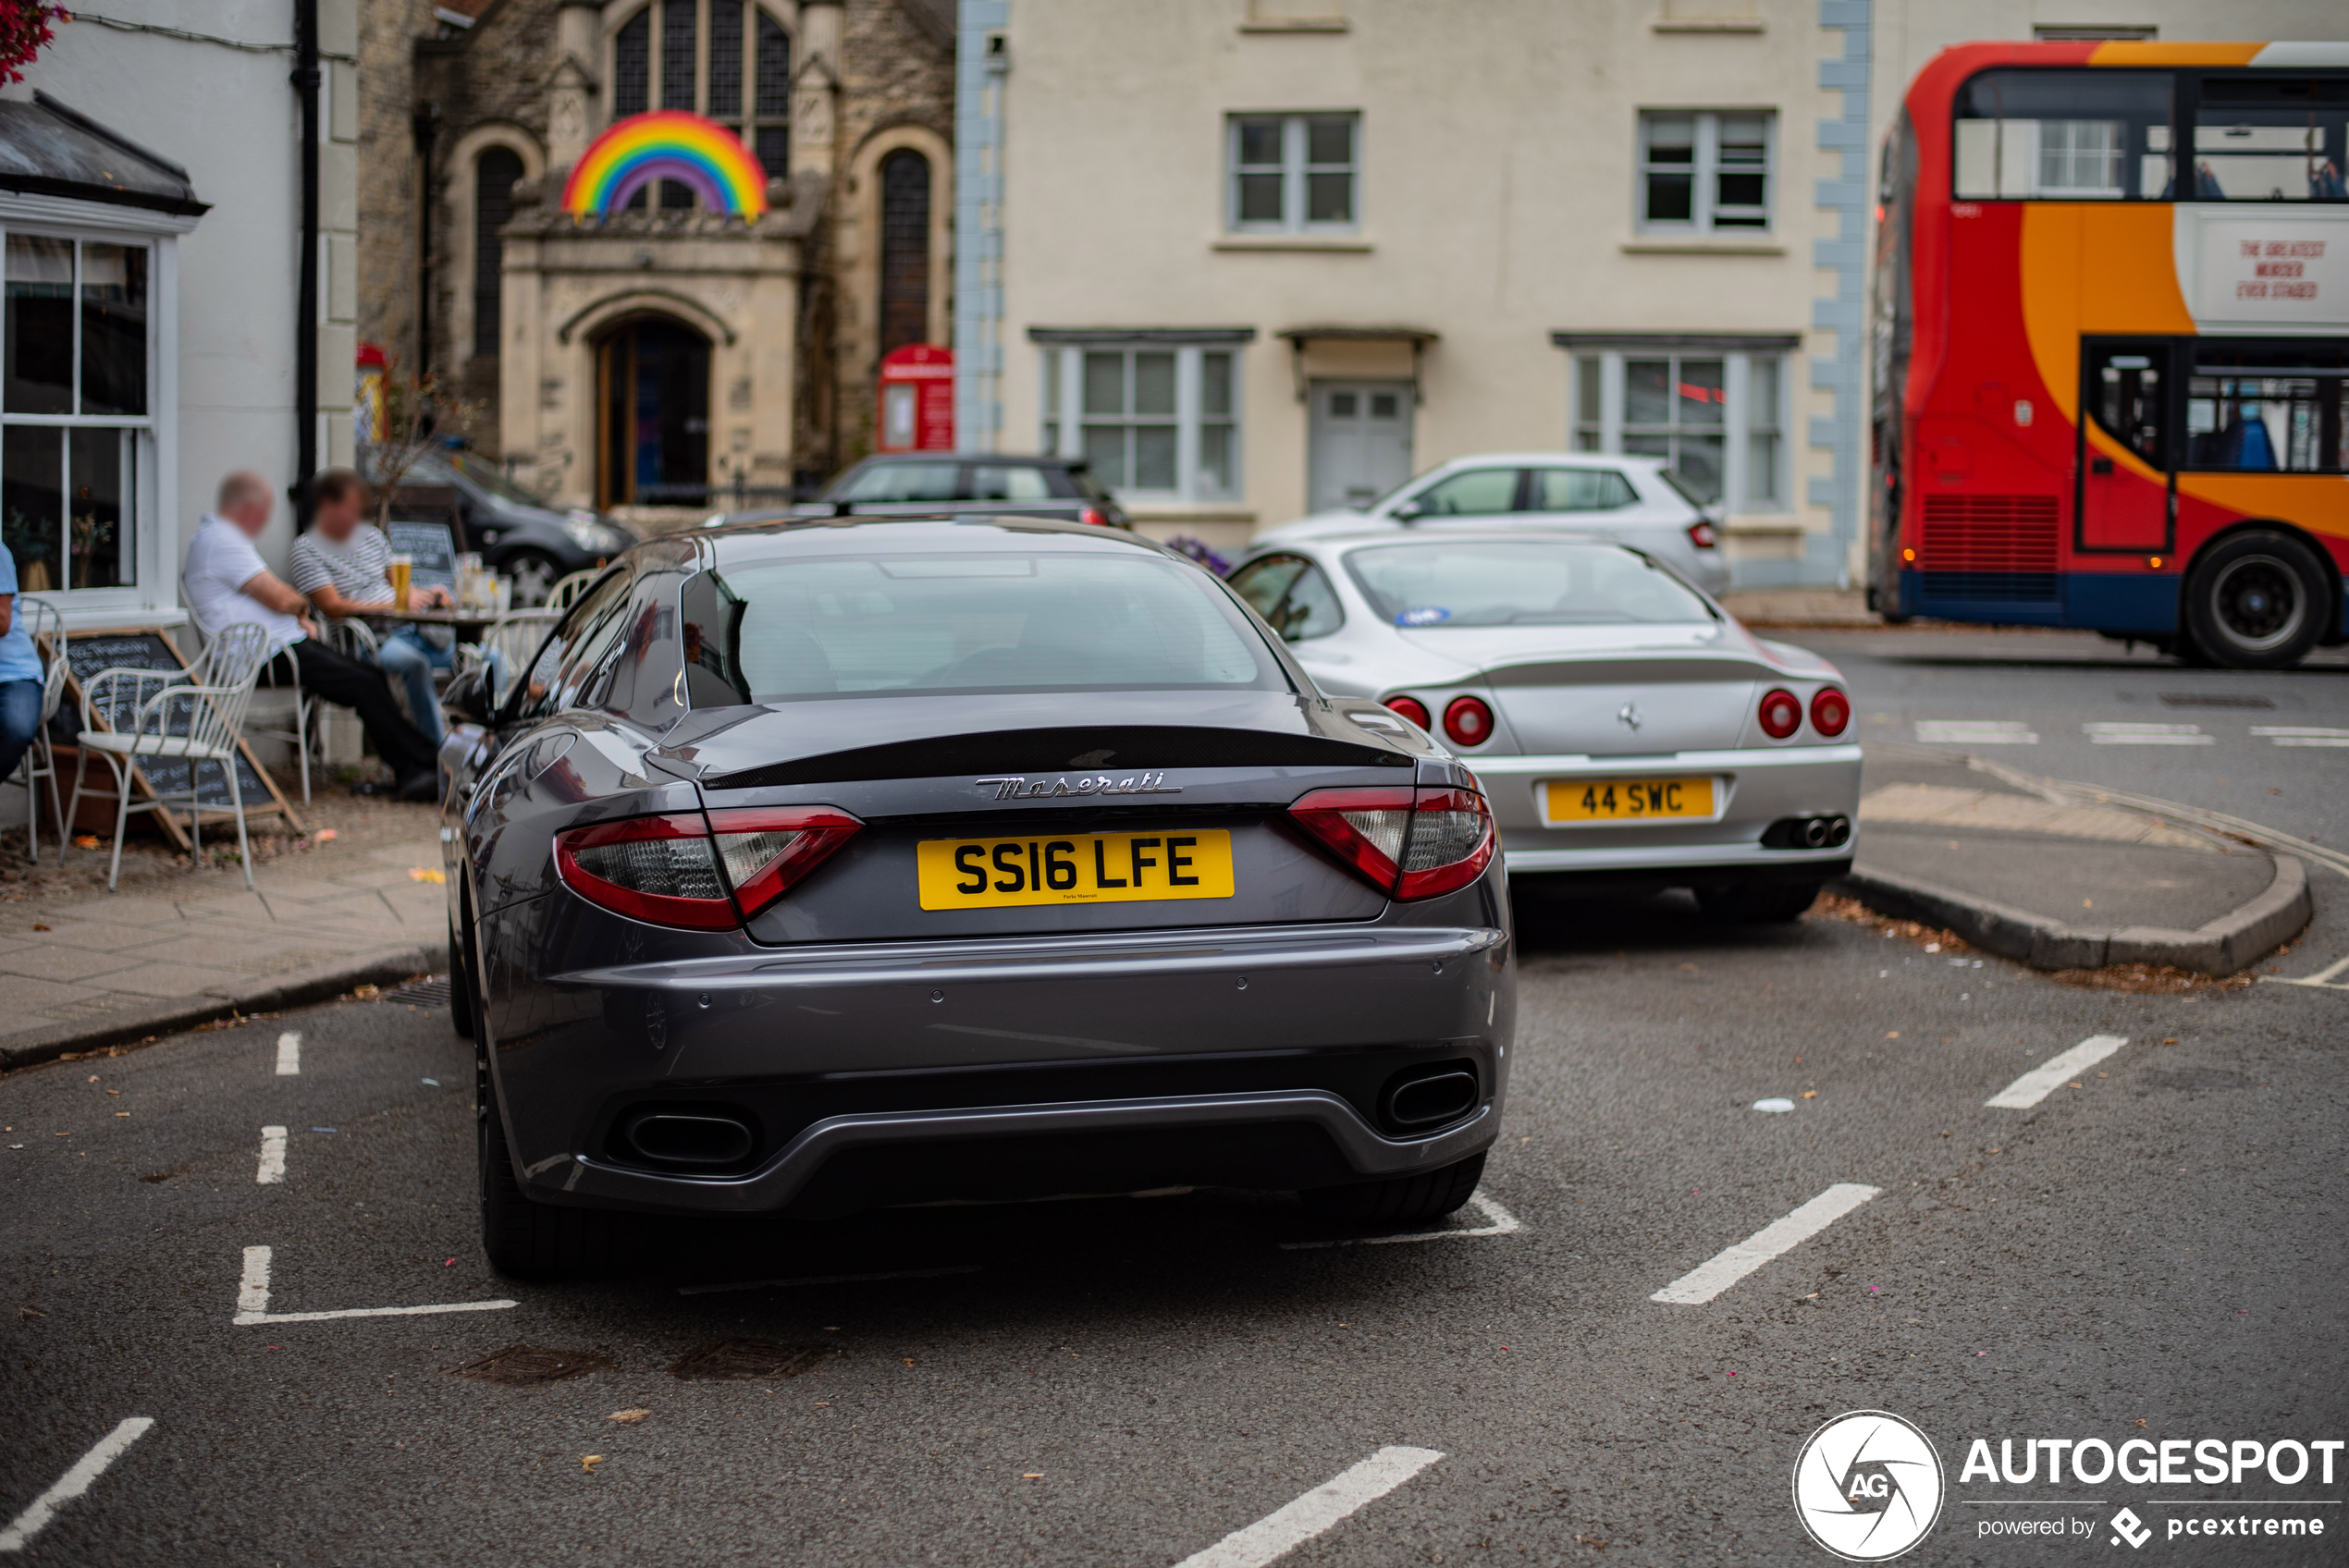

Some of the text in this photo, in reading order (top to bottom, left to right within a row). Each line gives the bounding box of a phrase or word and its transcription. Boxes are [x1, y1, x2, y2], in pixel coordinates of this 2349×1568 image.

[2240, 240, 2327, 259] THE GREATEST
[2255, 261, 2304, 277] MURDER
[2236, 281, 2318, 300] EVER STAGED
[976, 772, 1183, 800] Maserati
[1581, 783, 1683, 814] 44 SWC
[954, 837, 1199, 894] SS16 LFE
